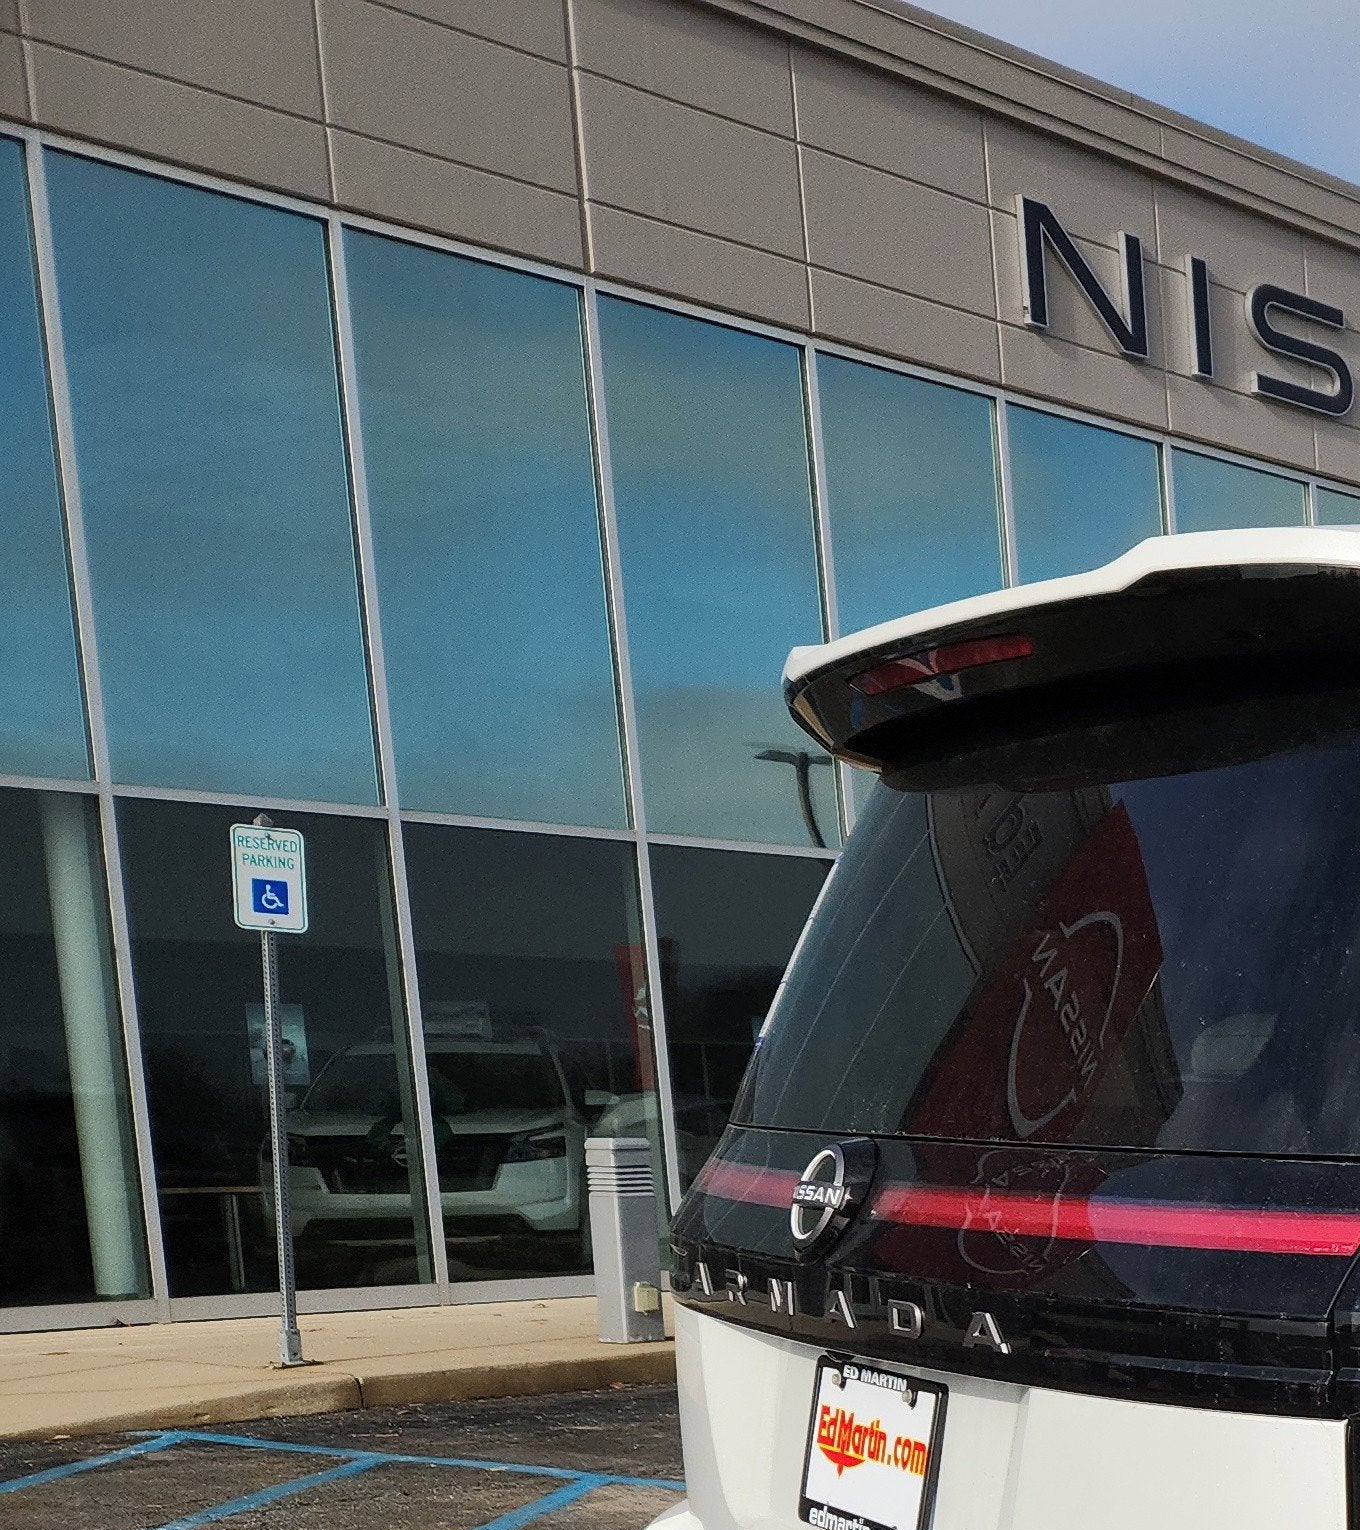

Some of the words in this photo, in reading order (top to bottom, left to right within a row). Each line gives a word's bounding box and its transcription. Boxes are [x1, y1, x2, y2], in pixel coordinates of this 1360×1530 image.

[236, 834, 298, 853] RESERVED
[242, 854, 295, 870] PARKING
[795, 1184, 841, 1205] SSAN
[690, 1261, 1012, 1354] ARMADA
[842, 1364, 859, 1380] ED
[860, 1370, 908, 1392] MARTIN
[816, 1404, 928, 1476] EdMartin.com
